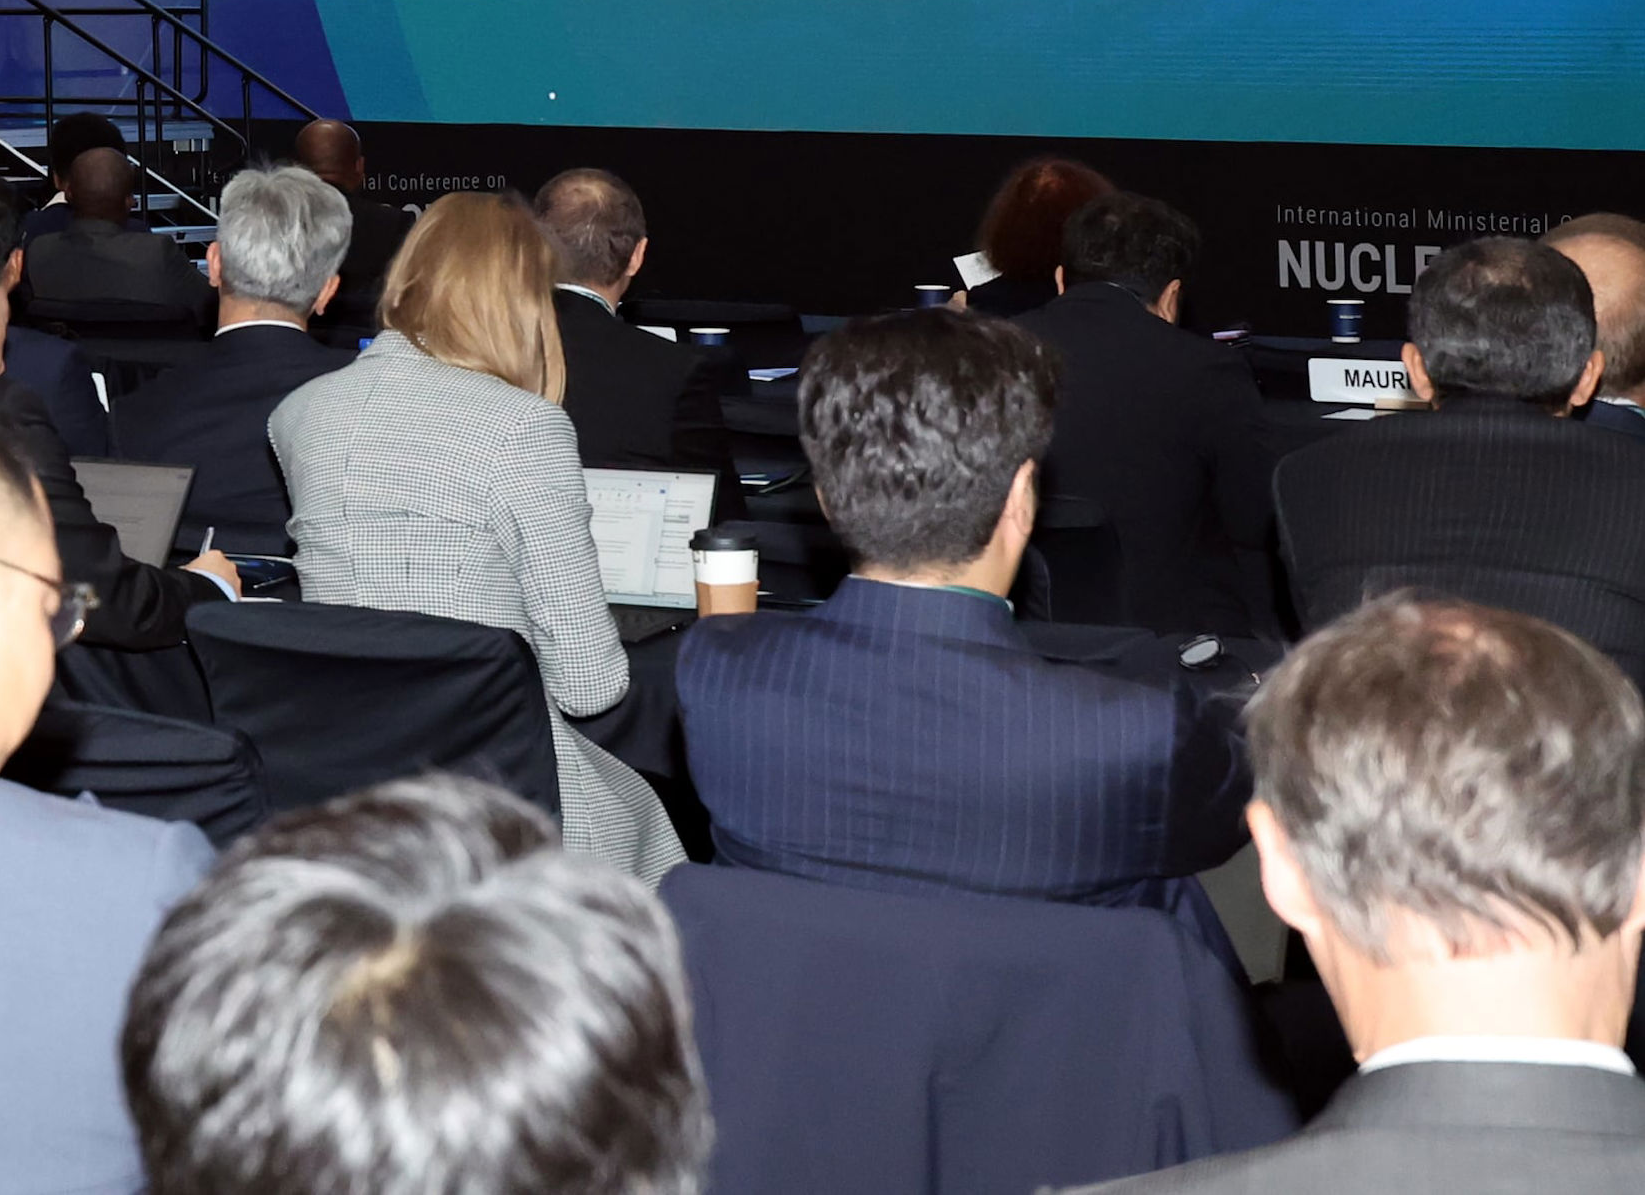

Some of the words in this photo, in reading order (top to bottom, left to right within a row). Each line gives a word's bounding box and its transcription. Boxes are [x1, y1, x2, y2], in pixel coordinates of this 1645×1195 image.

[388, 171, 480, 192] Conference
[486, 174, 507, 190] on
[1276, 203, 1417, 229] International
[1426, 208, 1551, 234] Ministerial
[1344, 369, 1411, 390] MAURI
